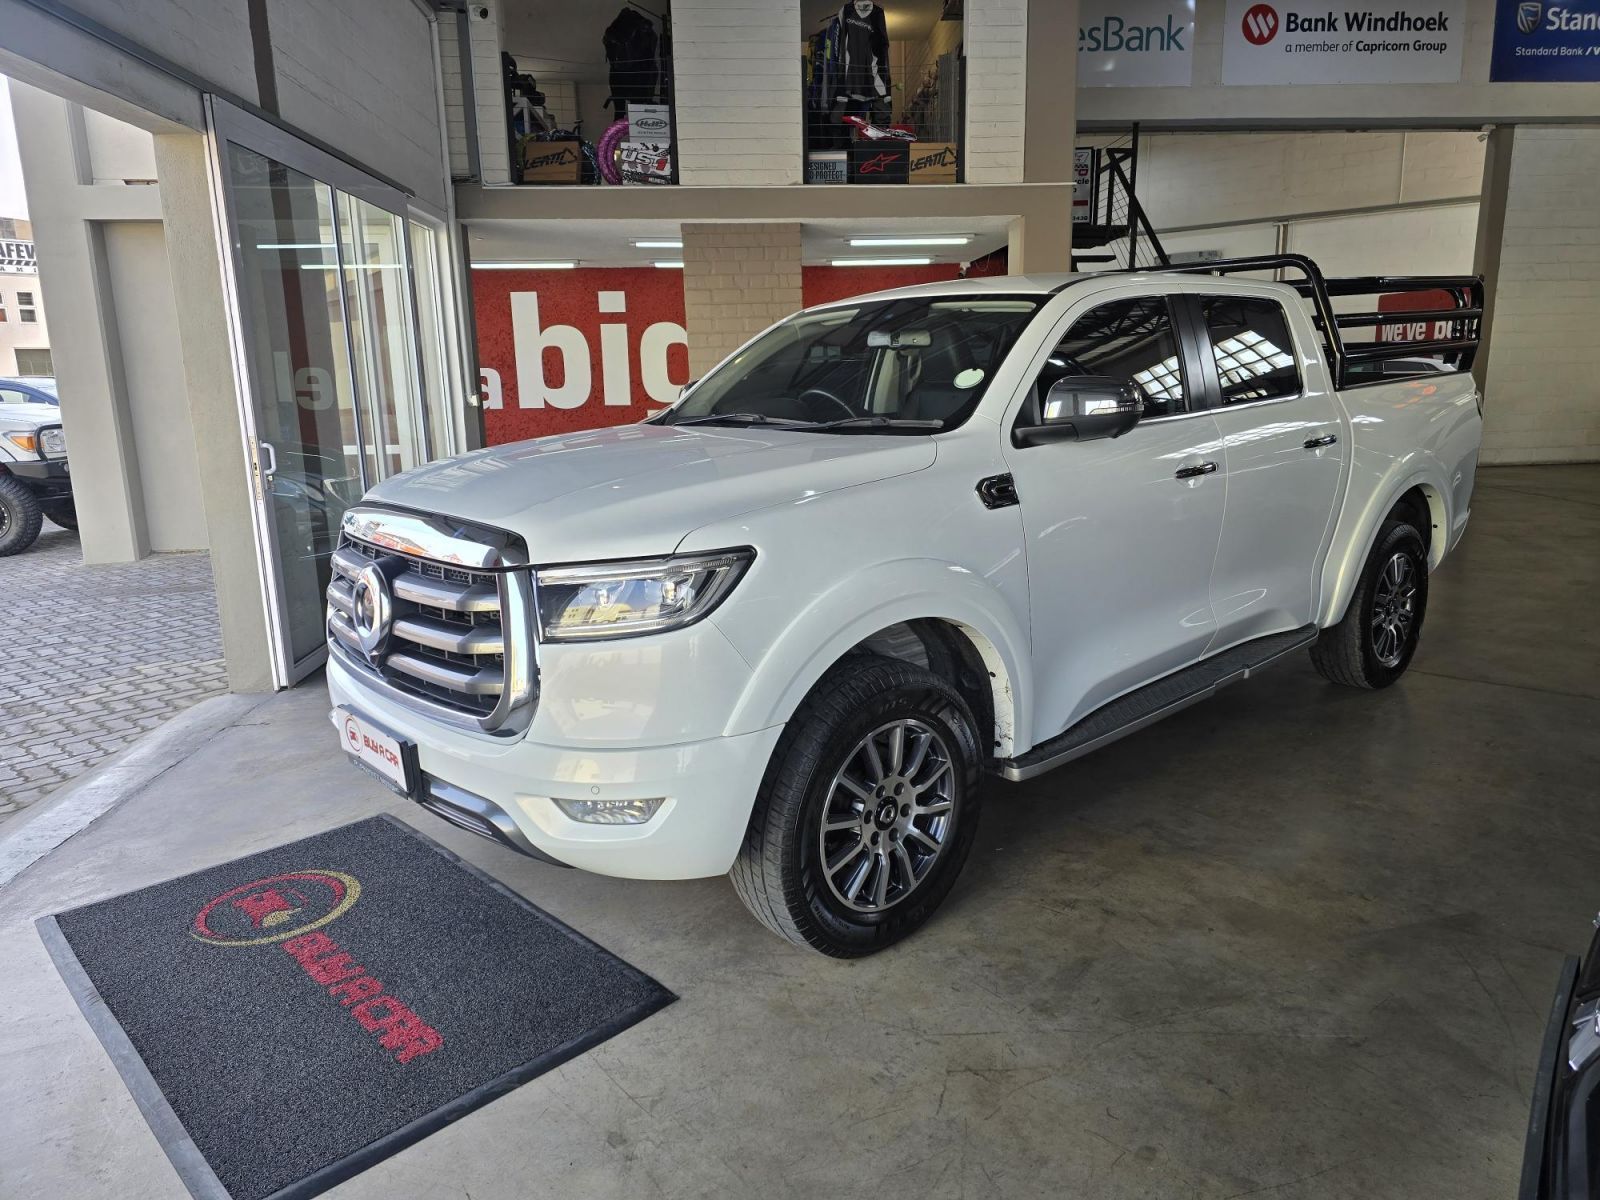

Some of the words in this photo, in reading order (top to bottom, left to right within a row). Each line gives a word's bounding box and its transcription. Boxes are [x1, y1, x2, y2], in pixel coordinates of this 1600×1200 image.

[1285, 11, 1338, 33] Bank
[1344, 10, 1449, 32] Windhoek
[1545, 7, 1600, 31] Stan
[1285, 44, 1293, 52] a
[1294, 41, 1340, 52] member
[1341, 40, 1354, 52] of
[1355, 40, 1410, 54] Capricorn
[1412, 39, 1447, 54] Group
[1515, 46, 1559, 56] Standard
[1560, 47, 1583, 56] Bank
